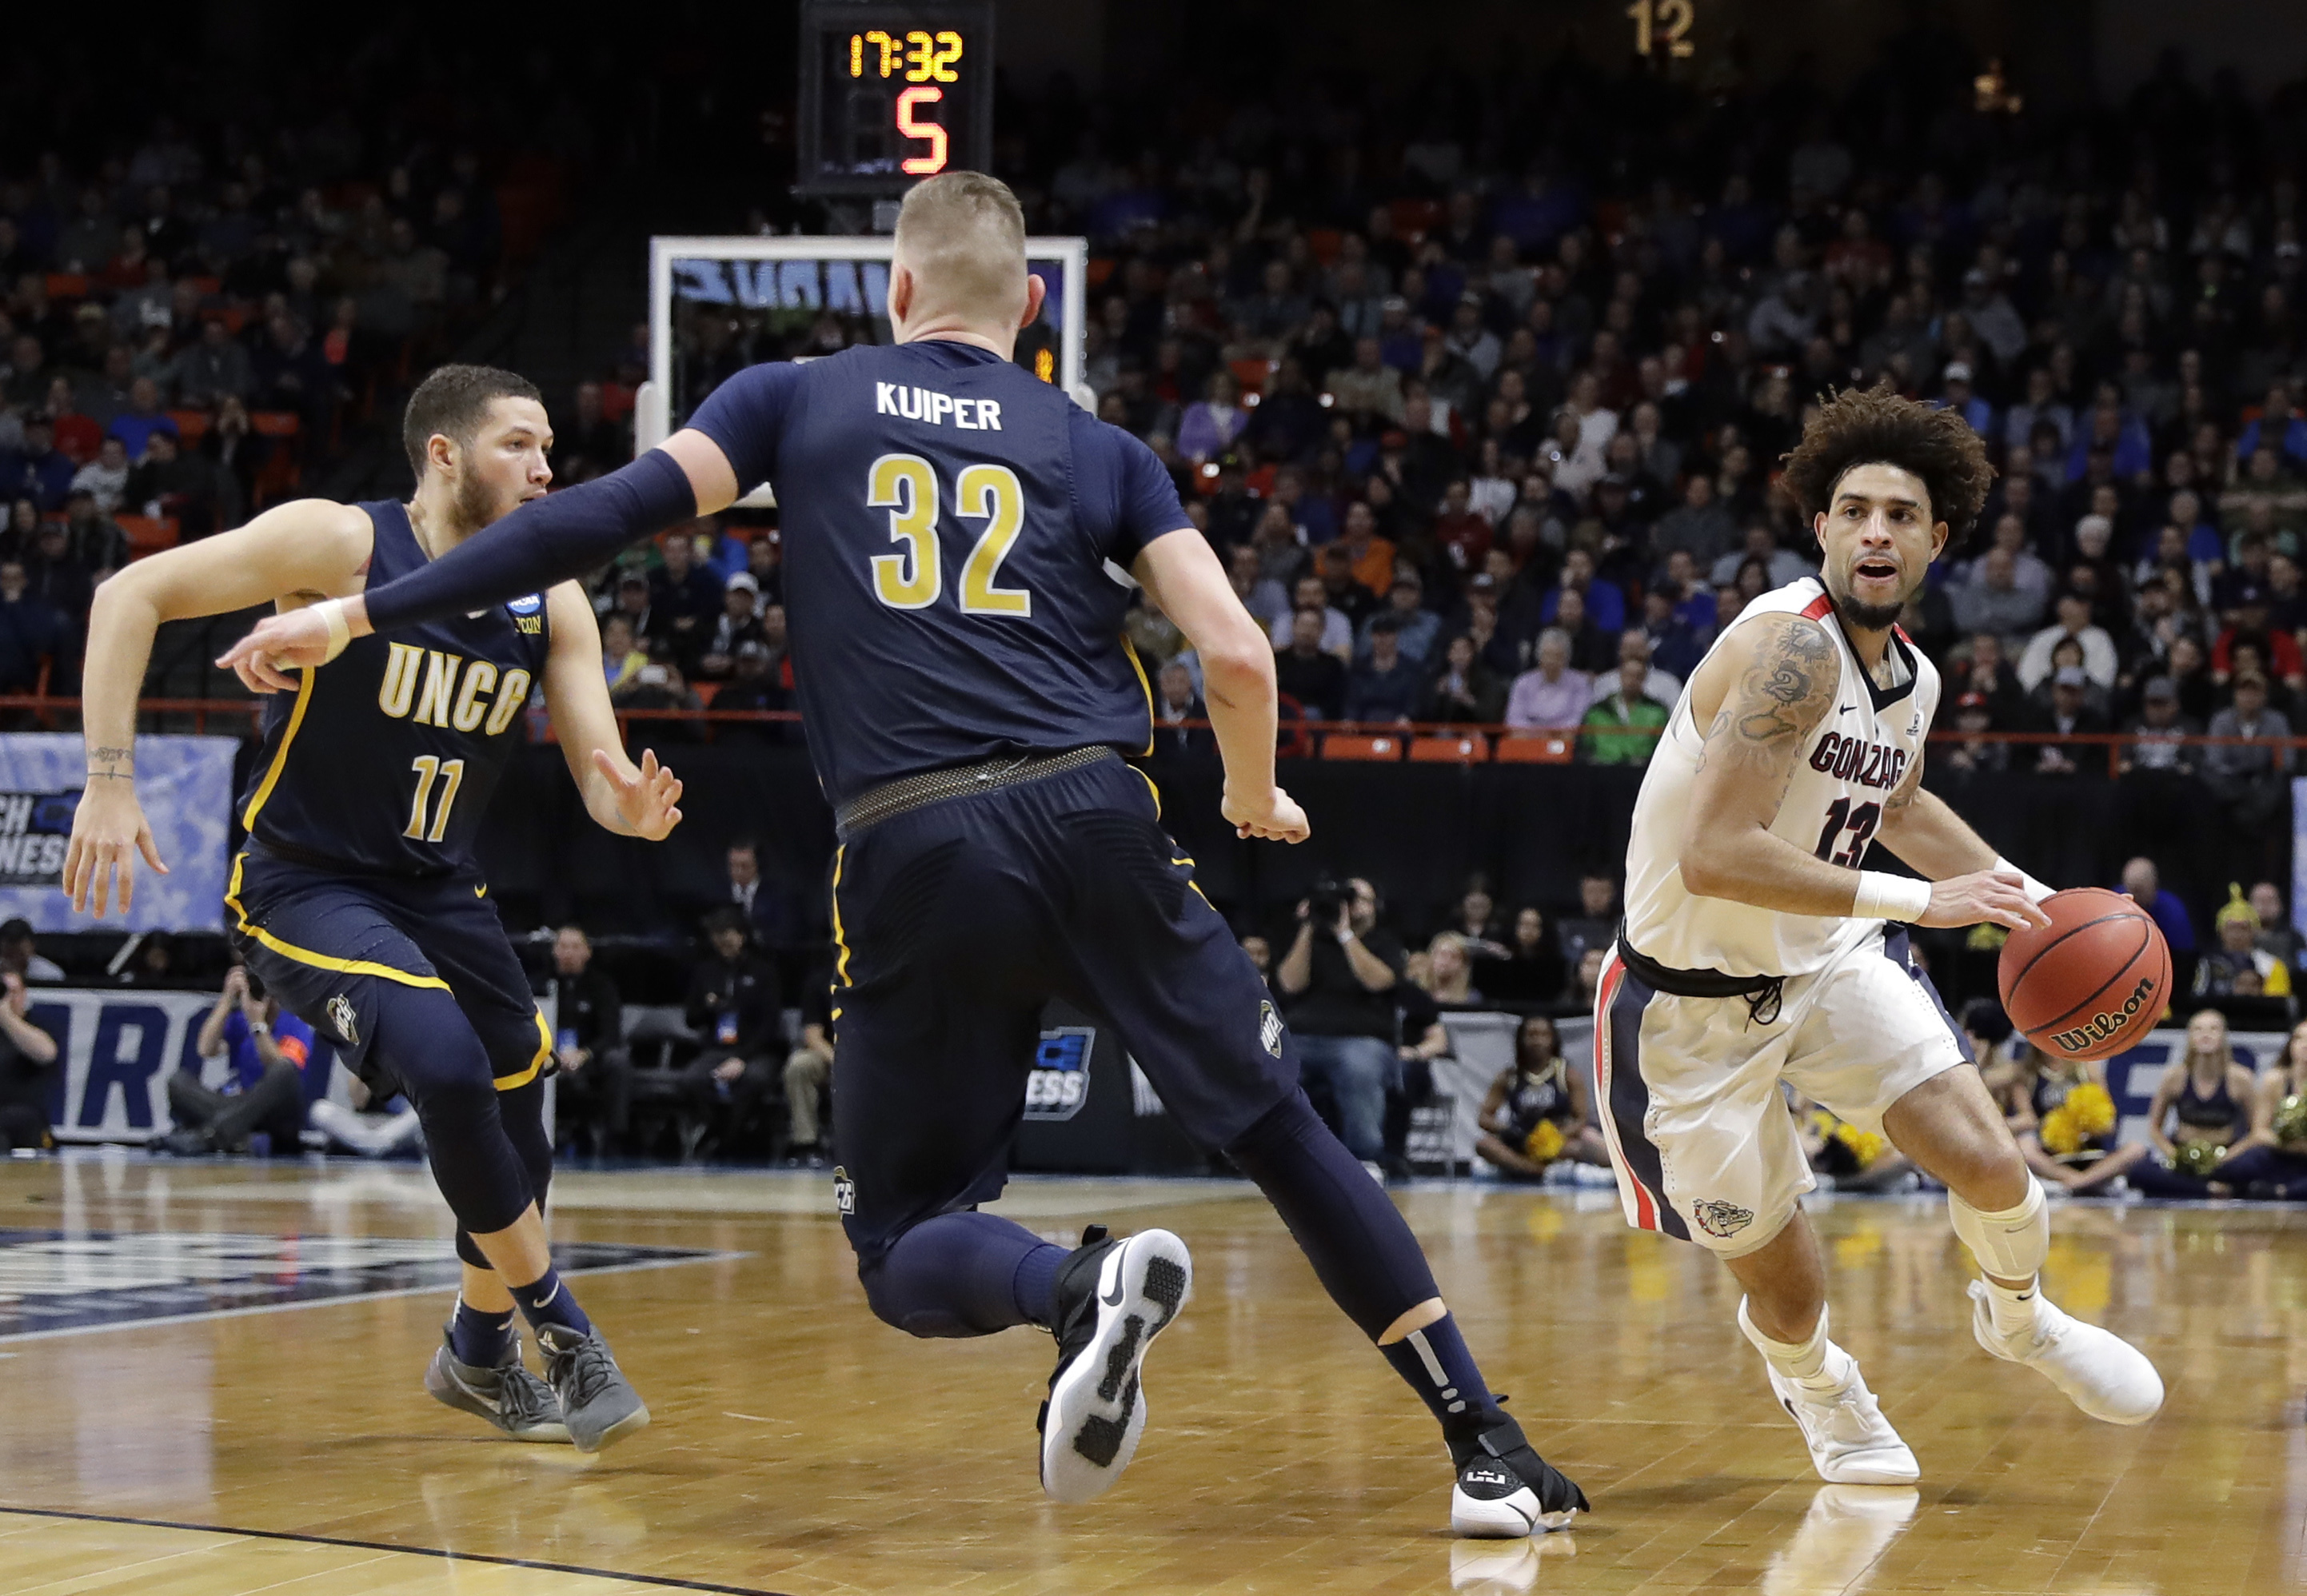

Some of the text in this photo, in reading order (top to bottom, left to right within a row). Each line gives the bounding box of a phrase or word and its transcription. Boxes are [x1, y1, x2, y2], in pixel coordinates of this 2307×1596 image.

[850, 30, 963, 82] 17:32
[1625, 0, 1695, 57] 12
[896, 86, 948, 174] 5
[876, 381, 1003, 431] KUIPER
[867, 453, 1032, 618] 32
[378, 641, 531, 736] UNCG
[1809, 731, 1914, 791] GONZAG
[401, 755, 465, 843] 11
[1814, 796, 1881, 869] 13
[2049, 976, 2154, 1053] Wilson
